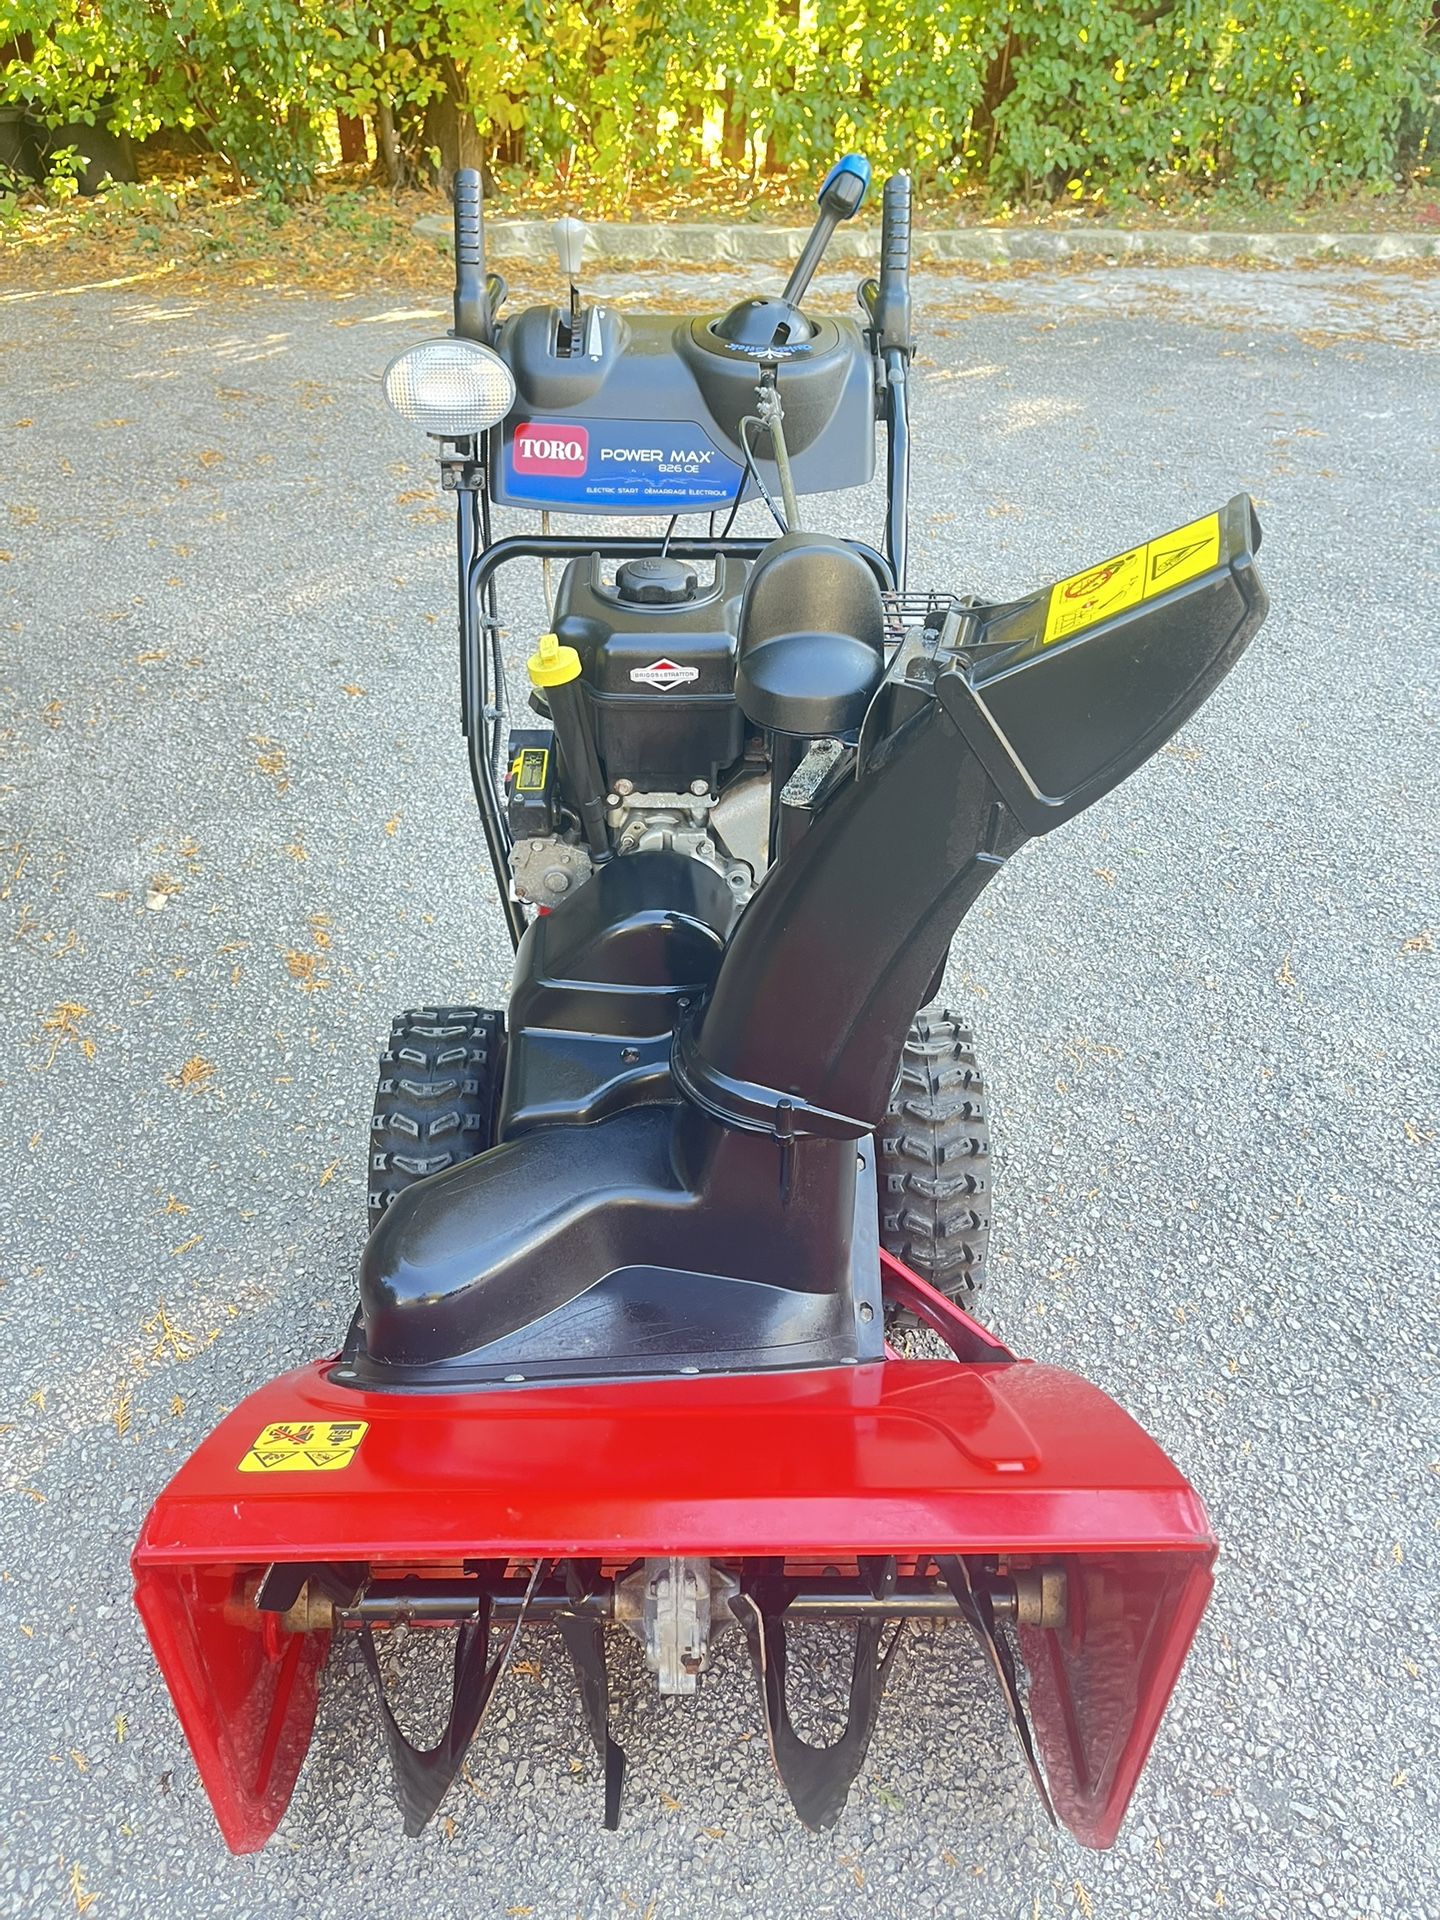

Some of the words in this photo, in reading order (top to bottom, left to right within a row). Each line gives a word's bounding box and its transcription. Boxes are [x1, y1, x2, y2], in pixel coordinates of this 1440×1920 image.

[600, 449, 664, 462] POWER
[658, 464, 683, 473] 826
[618, 487, 639, 495] START
